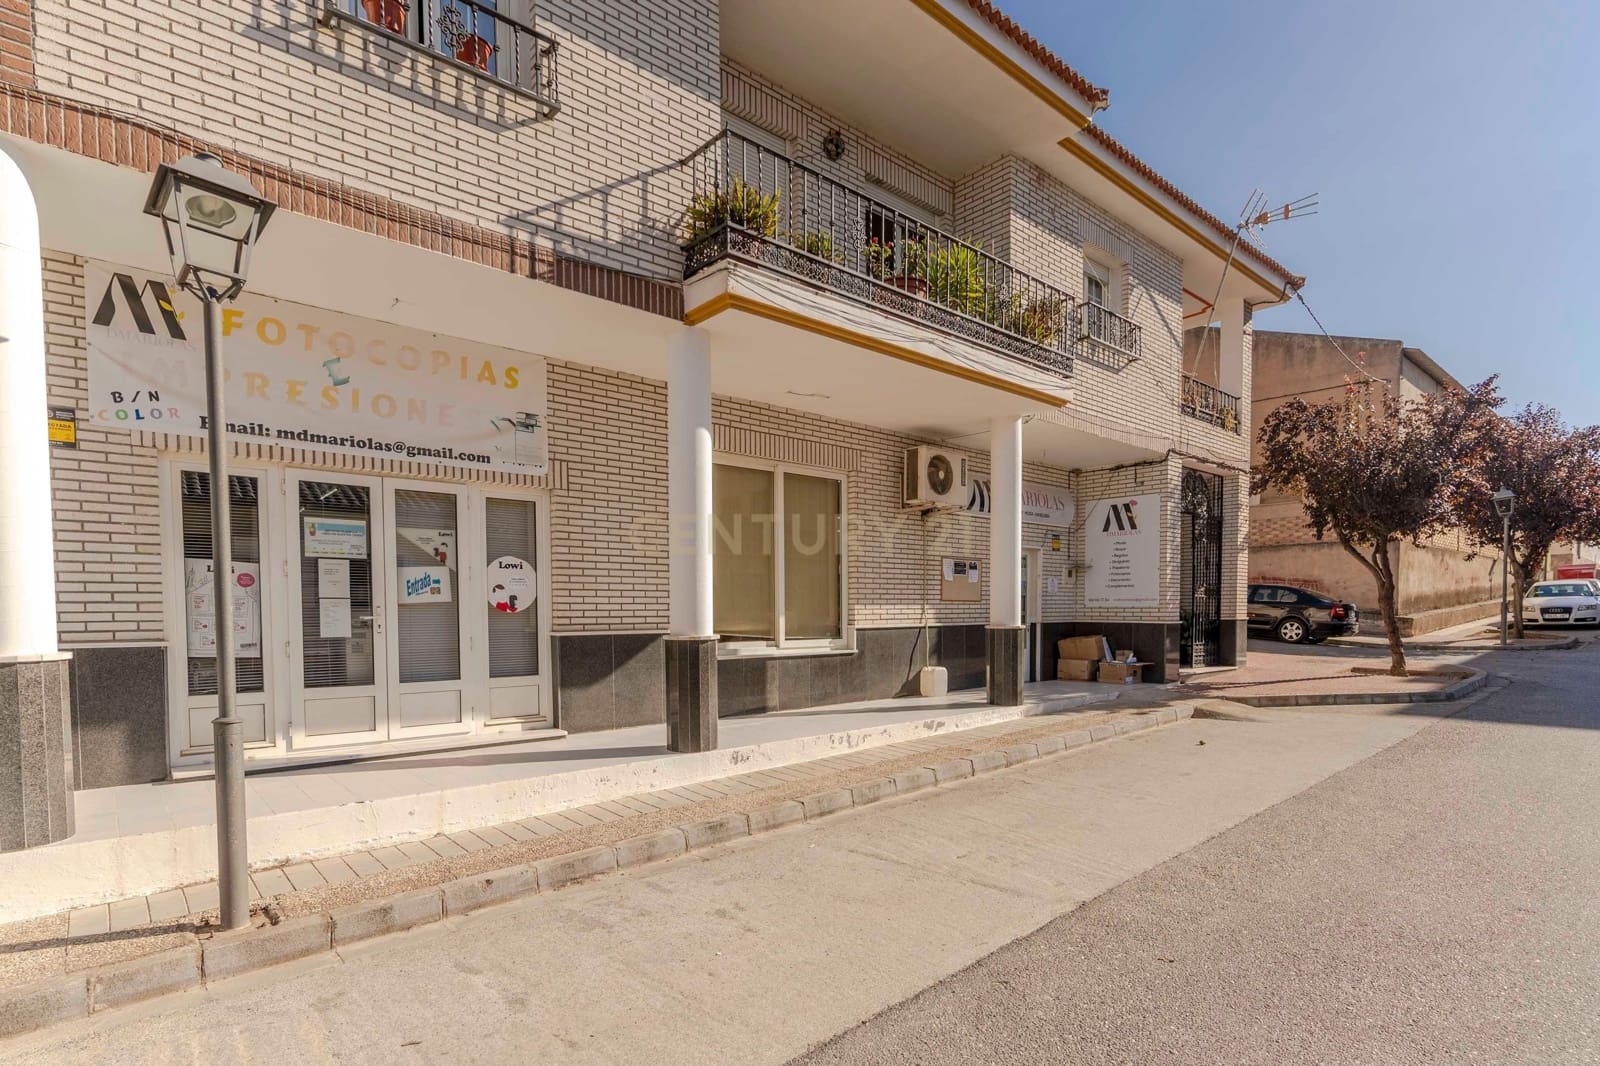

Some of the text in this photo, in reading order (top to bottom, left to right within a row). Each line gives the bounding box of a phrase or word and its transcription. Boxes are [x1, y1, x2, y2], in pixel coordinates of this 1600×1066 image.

[221, 308, 521, 391] FOTOCOPIAS
[97, 407, 180, 421] COLOR
[276, 428, 491, 465] mdmariolas@gmail.com
[498, 560, 524, 570] Lowi
[406, 572, 432, 597] Entrada
